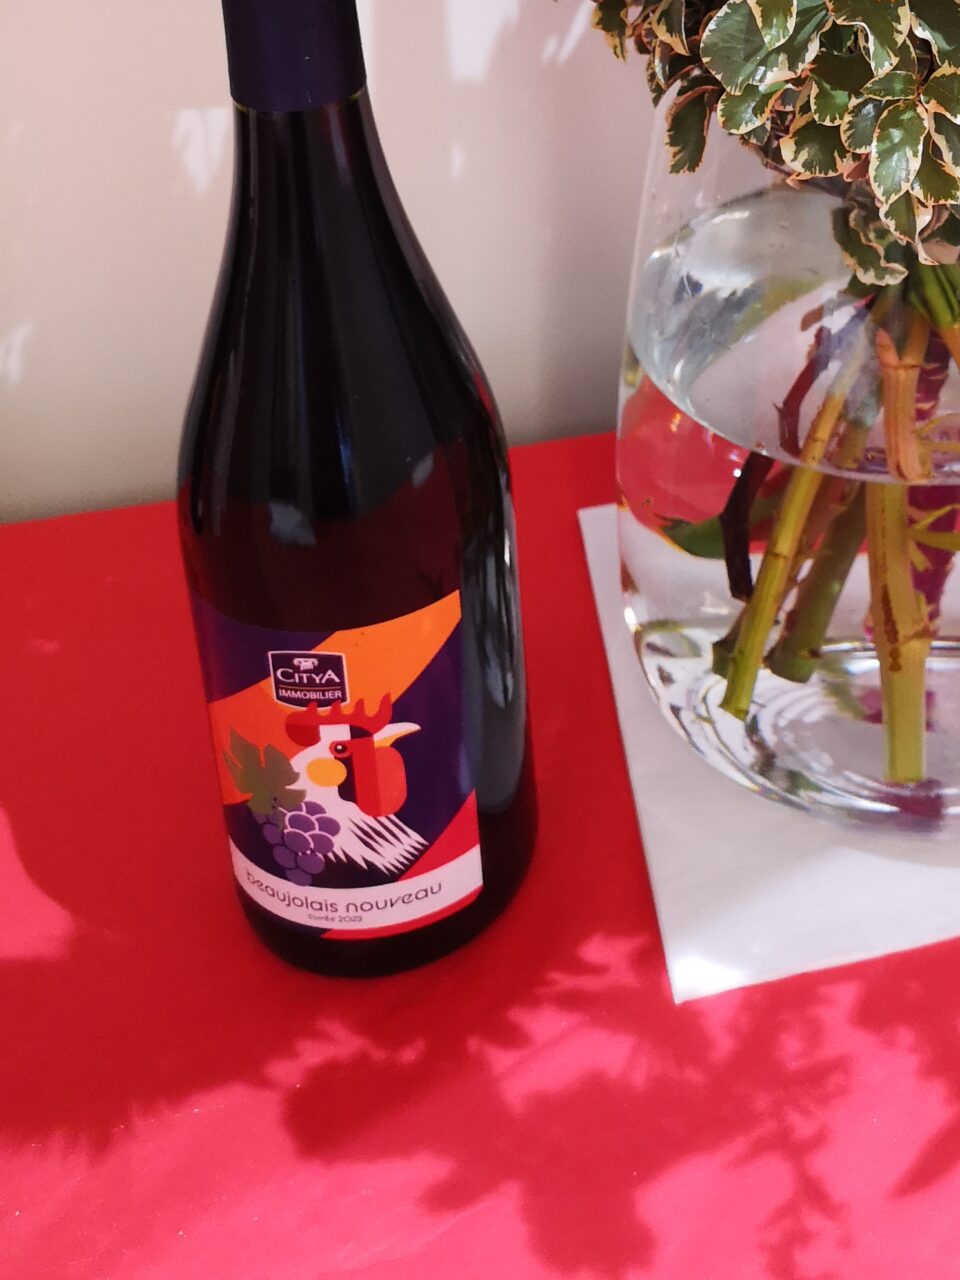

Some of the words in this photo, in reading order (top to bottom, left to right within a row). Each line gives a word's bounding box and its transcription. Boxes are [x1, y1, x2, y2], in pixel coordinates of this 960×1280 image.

[276, 667, 341, 684] CITYA
[278, 688, 343, 700] IMMOBILIER
[245, 870, 339, 914] beaujolais
[345, 881, 443, 914] nouveau
